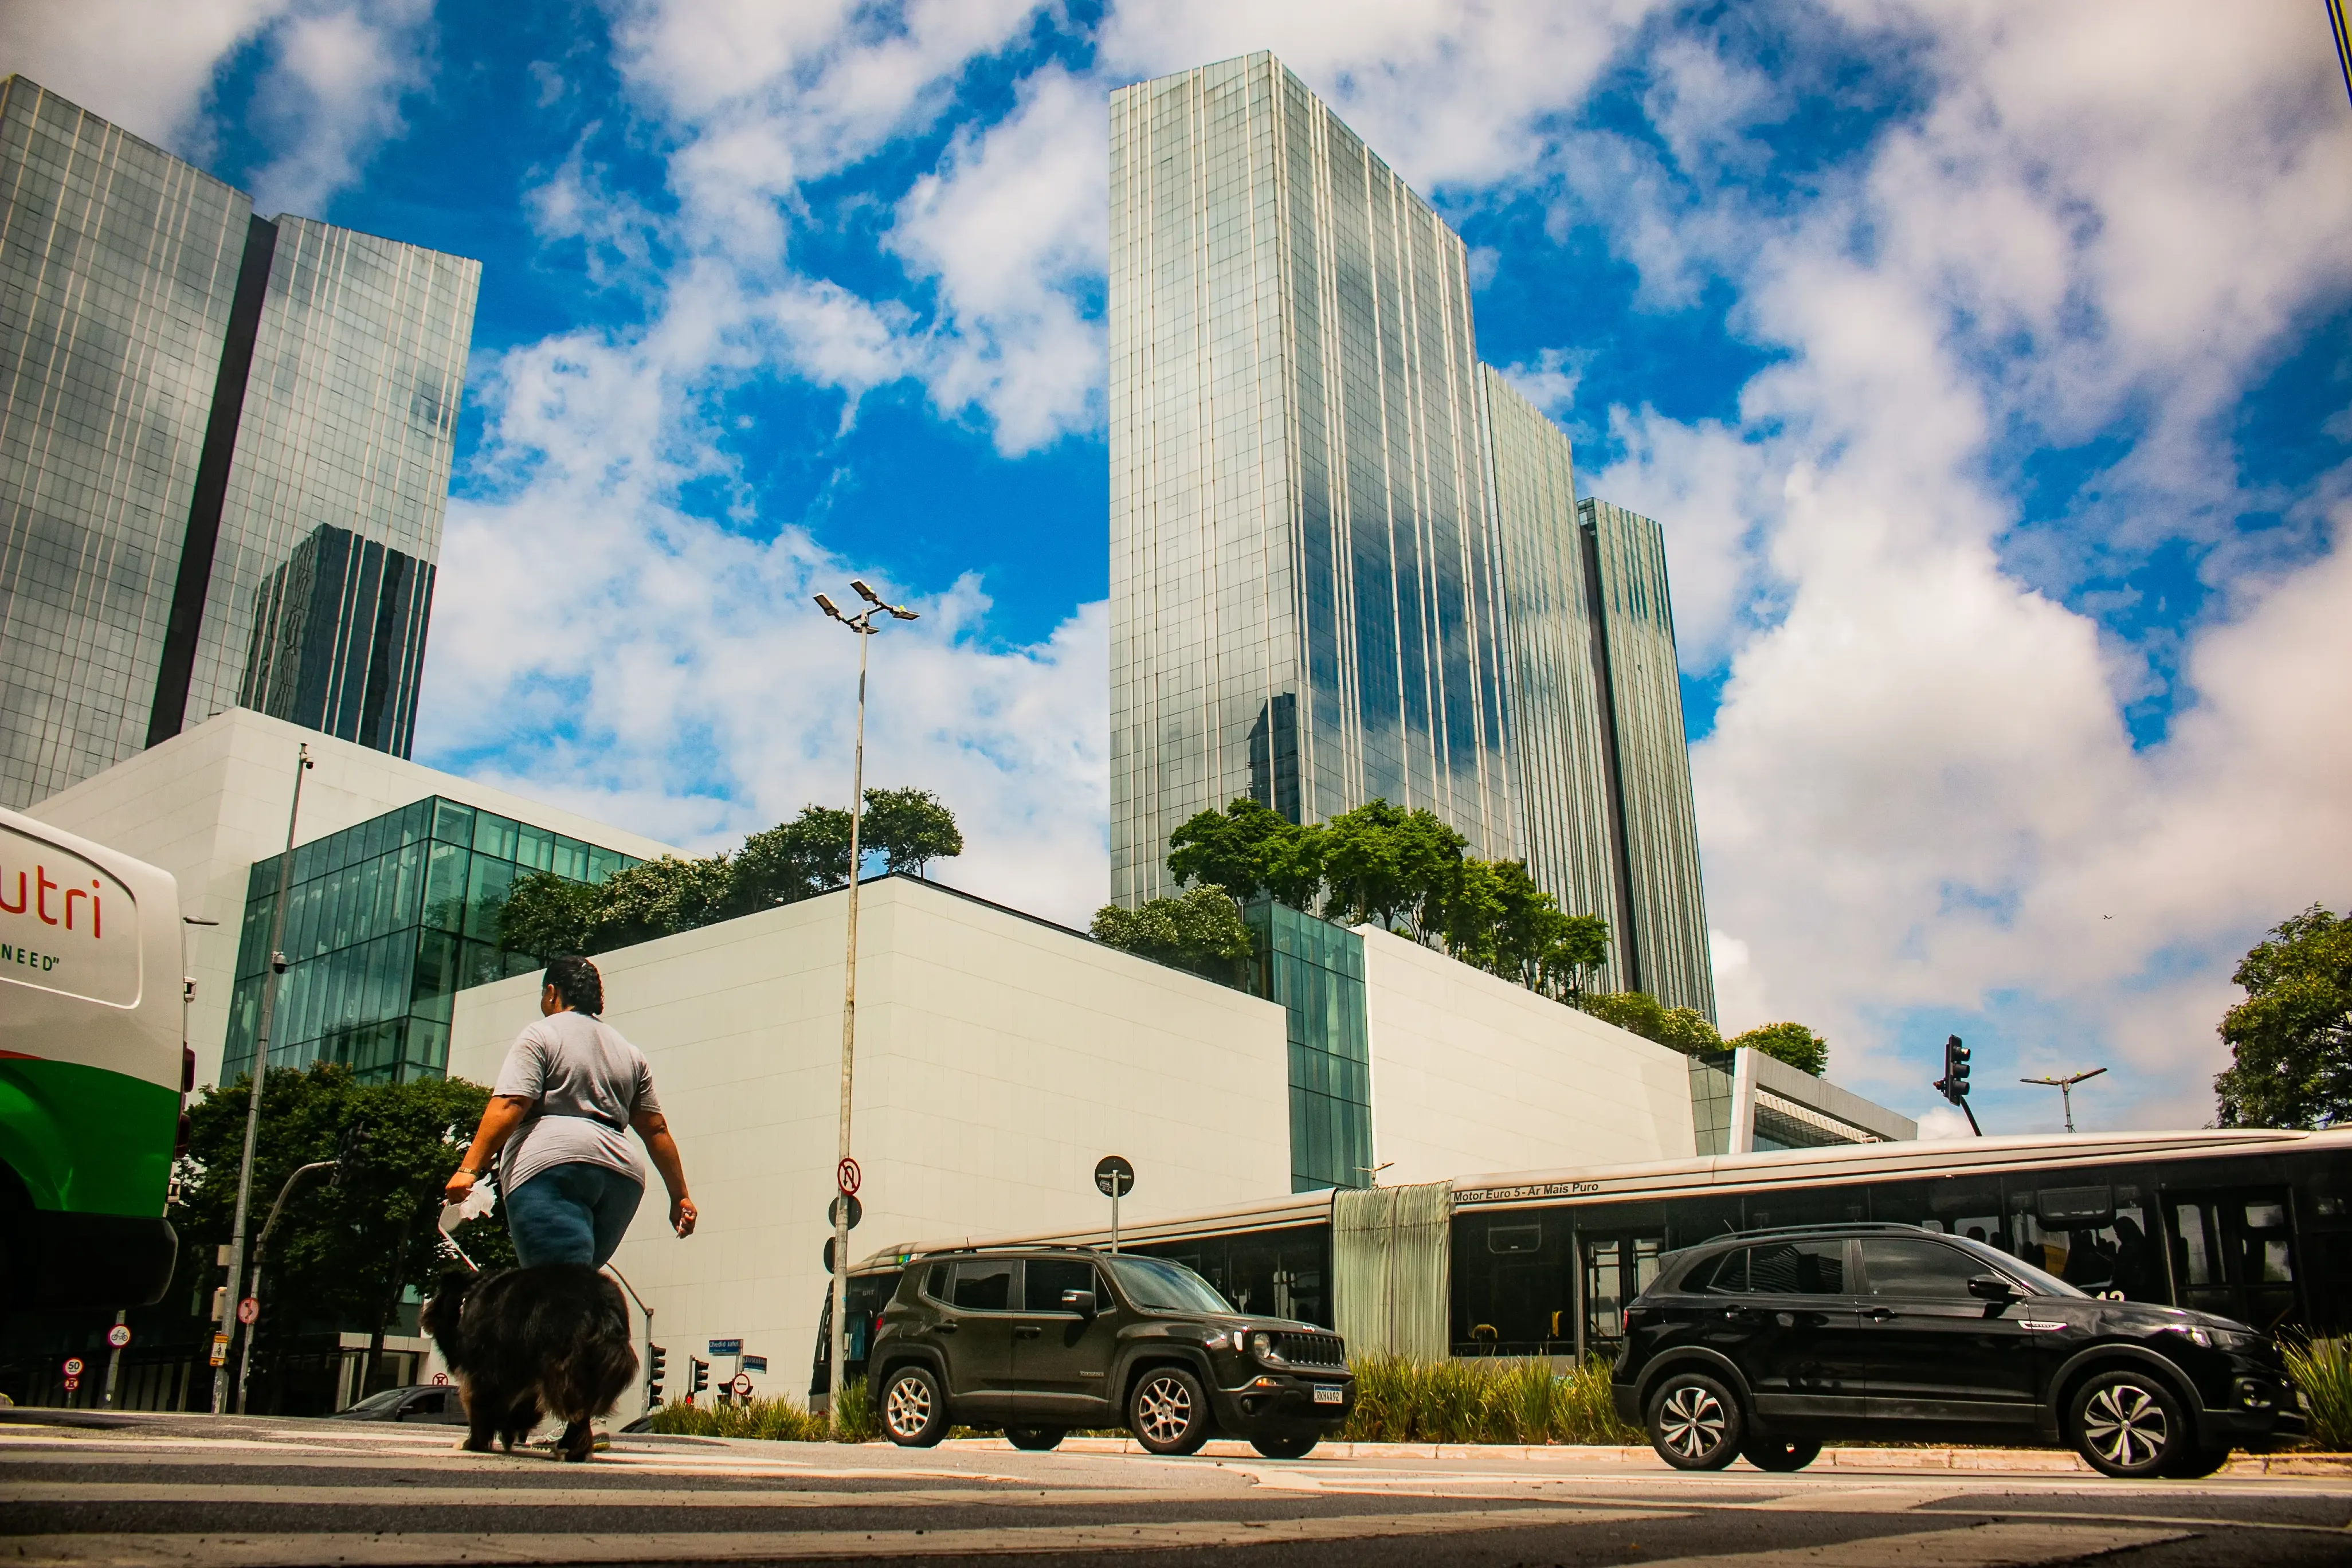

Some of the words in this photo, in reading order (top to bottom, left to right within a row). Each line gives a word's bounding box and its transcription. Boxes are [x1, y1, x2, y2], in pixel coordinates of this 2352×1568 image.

[1453, 1191, 1484, 1202] Motor
[1486, 1190, 1511, 1199] Euro
[1514, 1187, 1520, 1197] 5
[1527, 1185, 1540, 1196] Ar
[1543, 1184, 1569, 1194] Mais
[1573, 1182, 1598, 1192] Puro
[68, 1361, 80, 1370] 50
